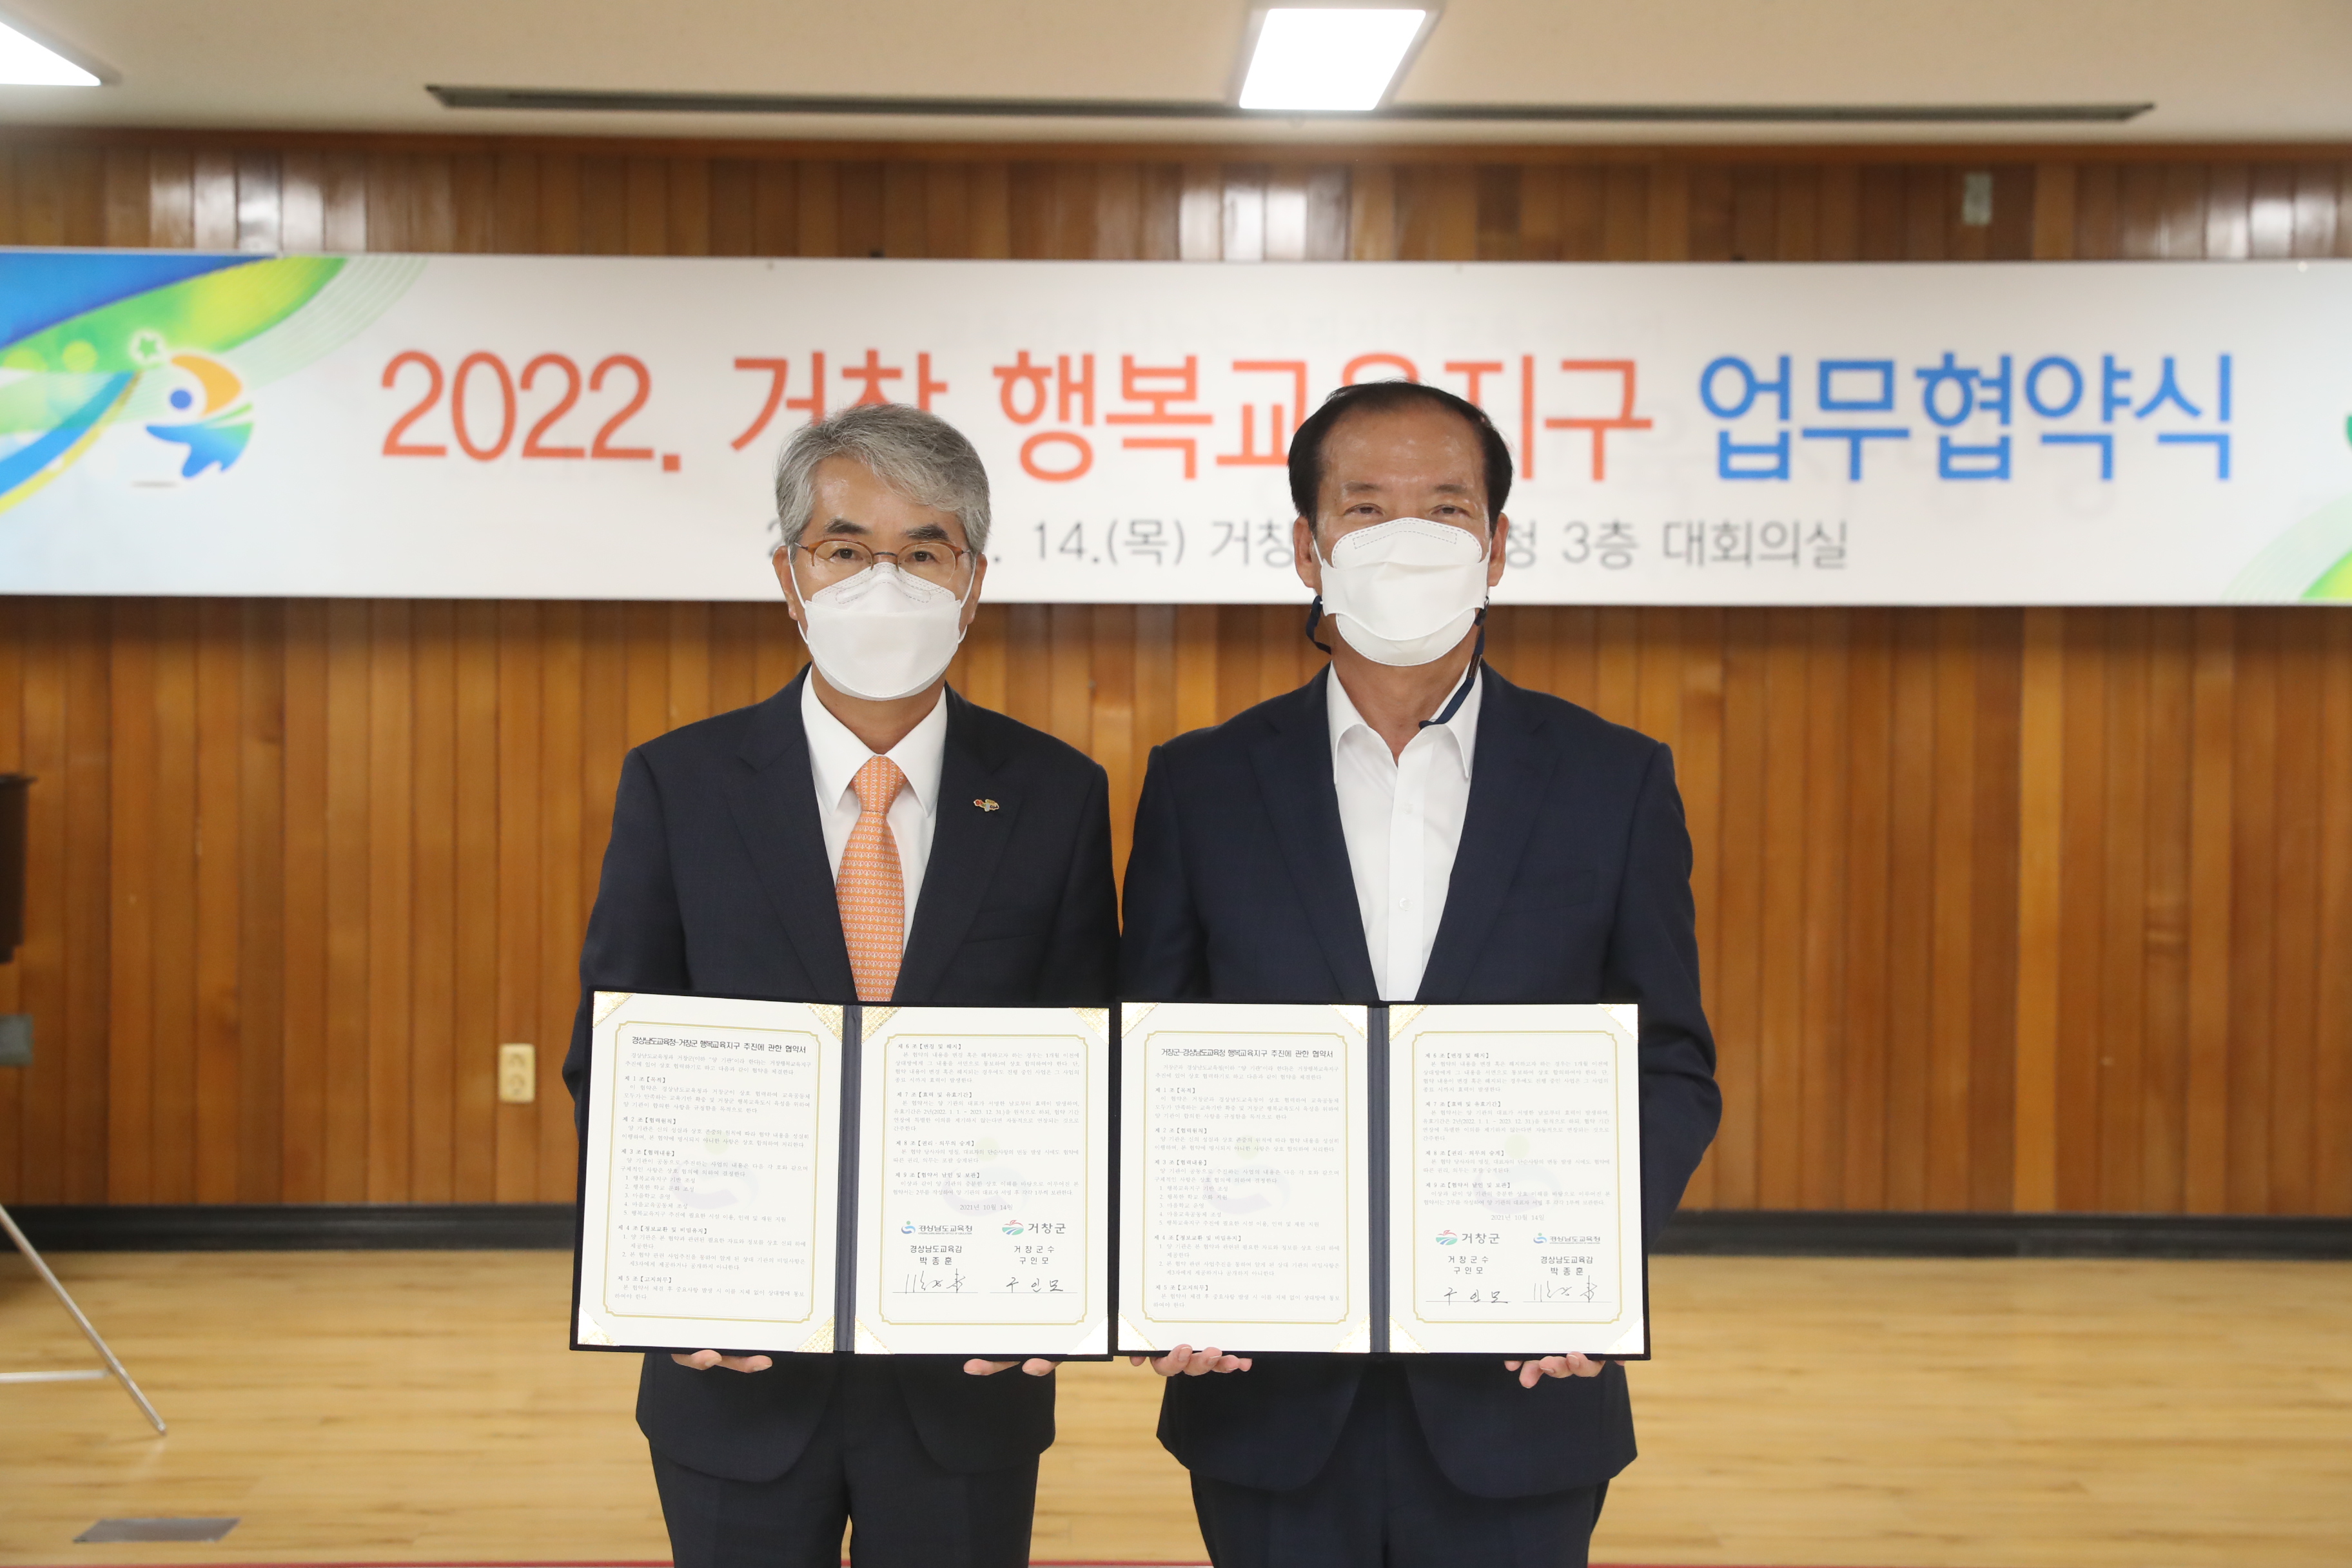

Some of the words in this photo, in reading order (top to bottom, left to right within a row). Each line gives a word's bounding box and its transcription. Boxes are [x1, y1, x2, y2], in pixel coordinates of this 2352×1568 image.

[381, 350, 681, 473] 2022.
[993, 350, 1653, 482] 행복교지구
[1700, 353, 2232, 482] 업무협약식
[1032, 519, 1185, 567] 14.(목)
[1562, 519, 1640, 570] 3층
[1662, 519, 1848, 570] 대회의실
[700, 1040, 740, 1050] 행복교육지구
[743, 1043, 764, 1051] 추진에
[768, 1044, 782, 1052] 관한
[785, 1044, 806, 1054] 협약서
[1228, 1049, 1267, 1057] 행복교육지구
[1312, 1050, 1333, 1058] 협약서
[1028, 1223, 1066, 1233] 거창군
[1462, 1233, 1500, 1244] 거창군
